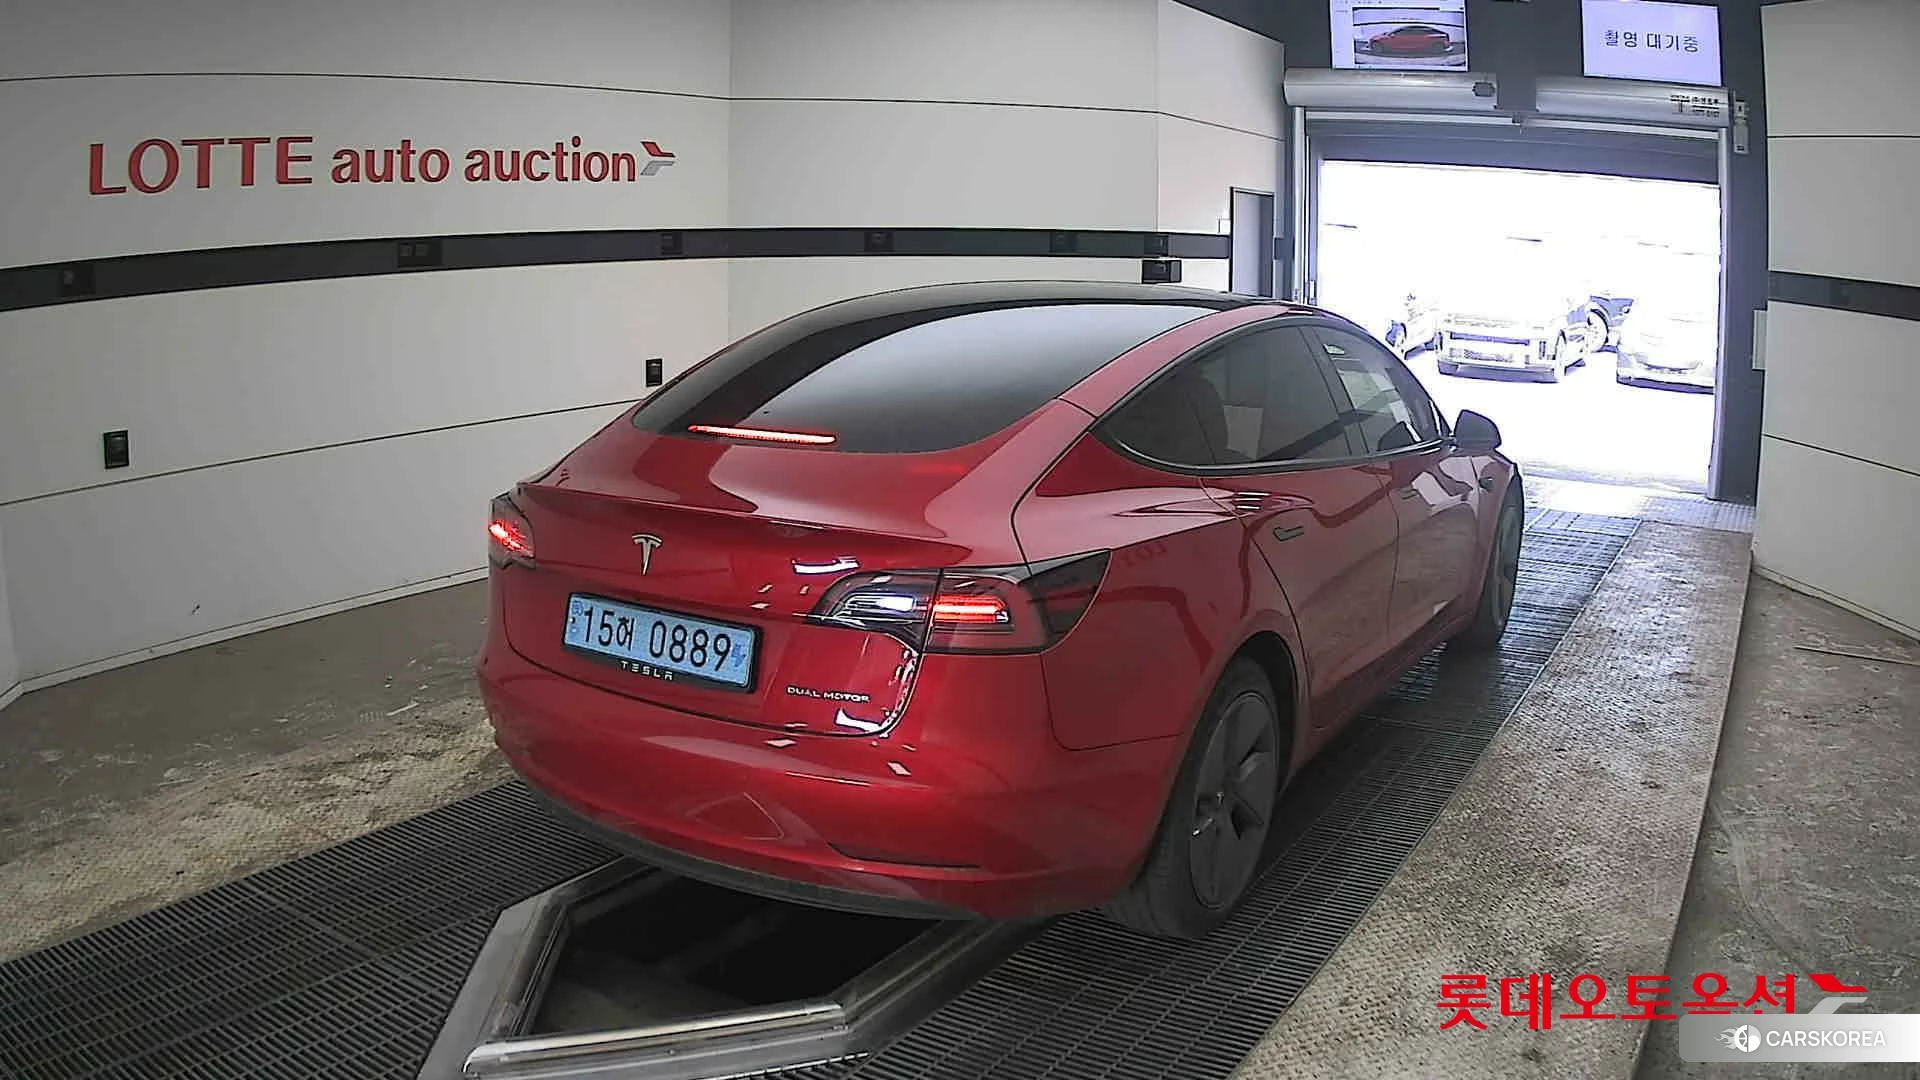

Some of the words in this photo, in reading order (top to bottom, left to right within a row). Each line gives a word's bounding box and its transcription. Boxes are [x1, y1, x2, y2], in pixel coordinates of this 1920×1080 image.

[1645, 33, 1698, 53] 대기중
[89, 135, 313, 196] LOTTE
[331, 139, 450, 184] auto
[464, 135, 638, 184] auction
[583, 605, 635, 651] 15허
[649, 619, 732, 672] 0889
[620, 660, 673, 681] TESLA
[787, 686, 821, 698] DUAL
[823, 691, 870, 703] MOTOR
